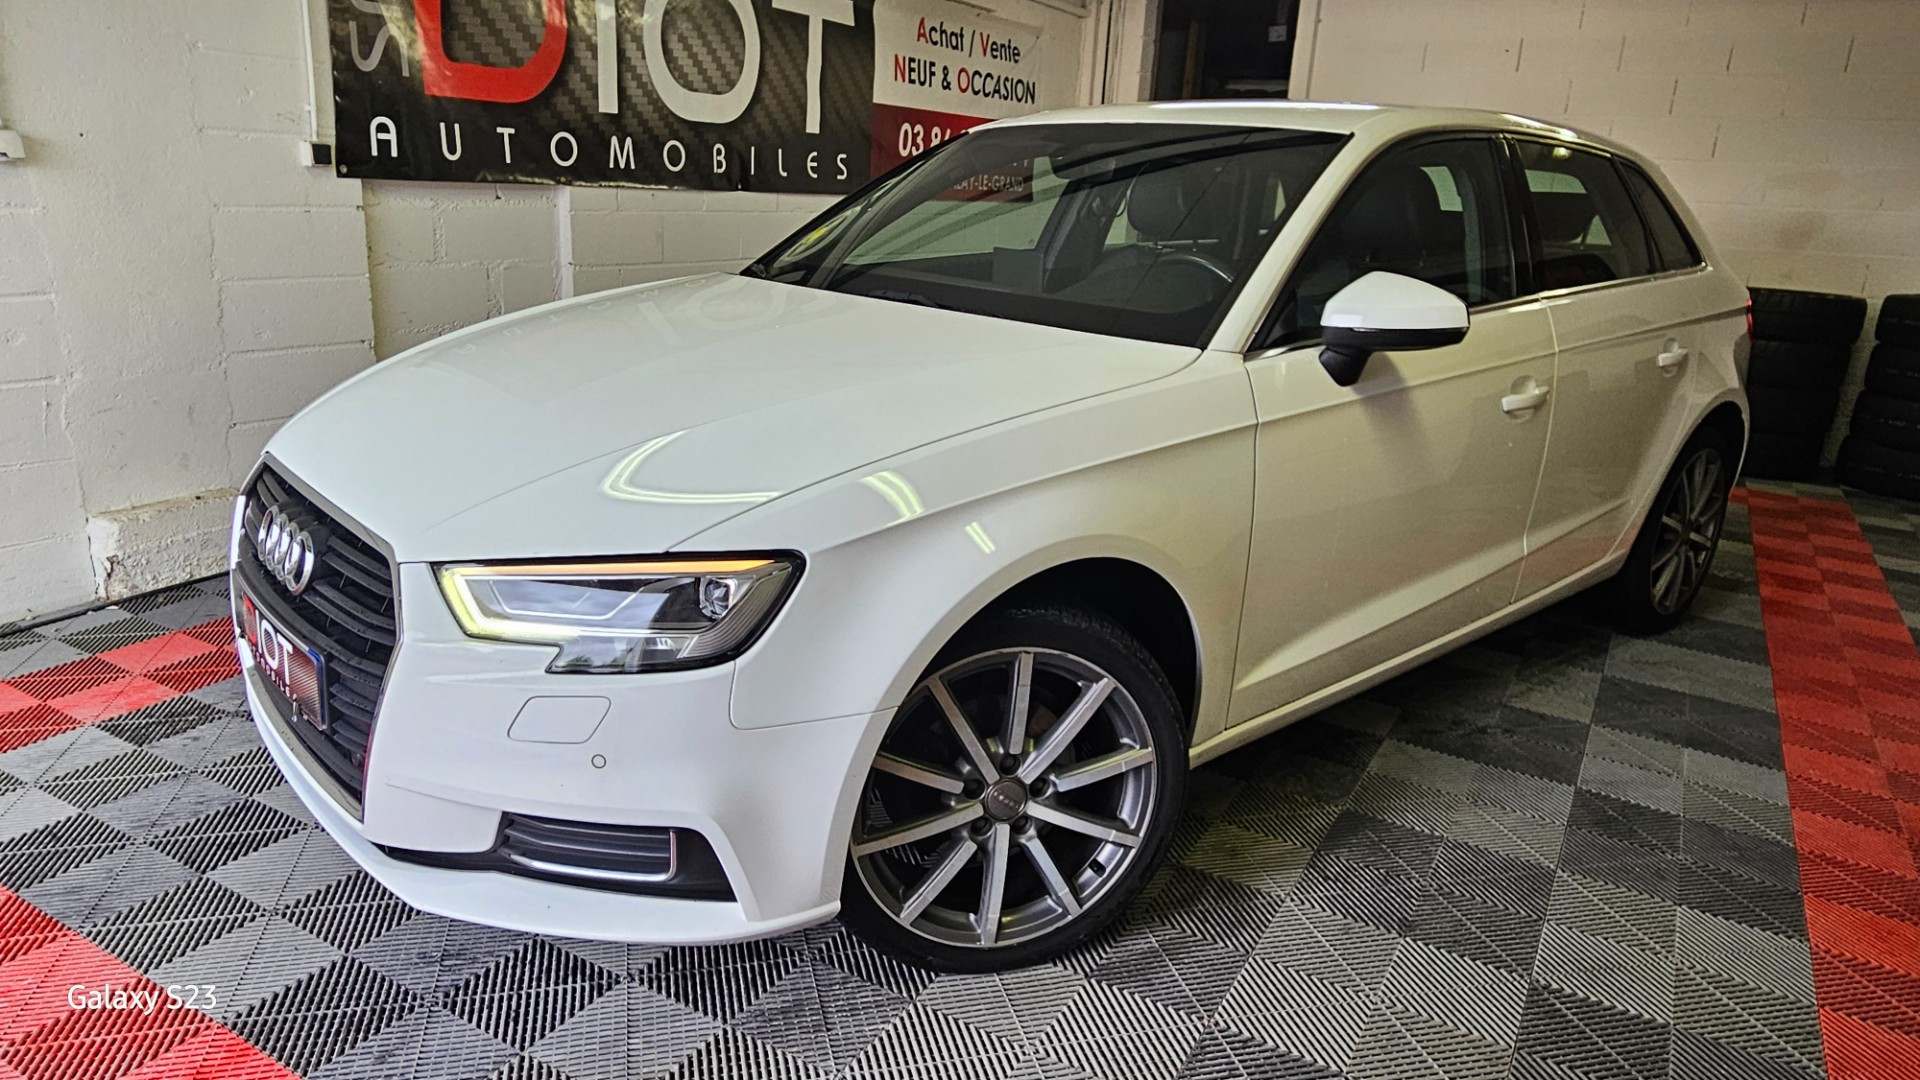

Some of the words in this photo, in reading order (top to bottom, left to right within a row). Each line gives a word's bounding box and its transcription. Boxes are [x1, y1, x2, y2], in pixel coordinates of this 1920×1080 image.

[916, 16, 965, 52] Achat
[968, 30, 976, 58] /
[980, 32, 1022, 64] Vente
[894, 53, 936, 88] NEUF
[941, 65, 952, 91] &
[957, 67, 1036, 105] OCCASION
[369, 116, 848, 180] AUTOMOBILES
[898, 122, 925, 157] 03
